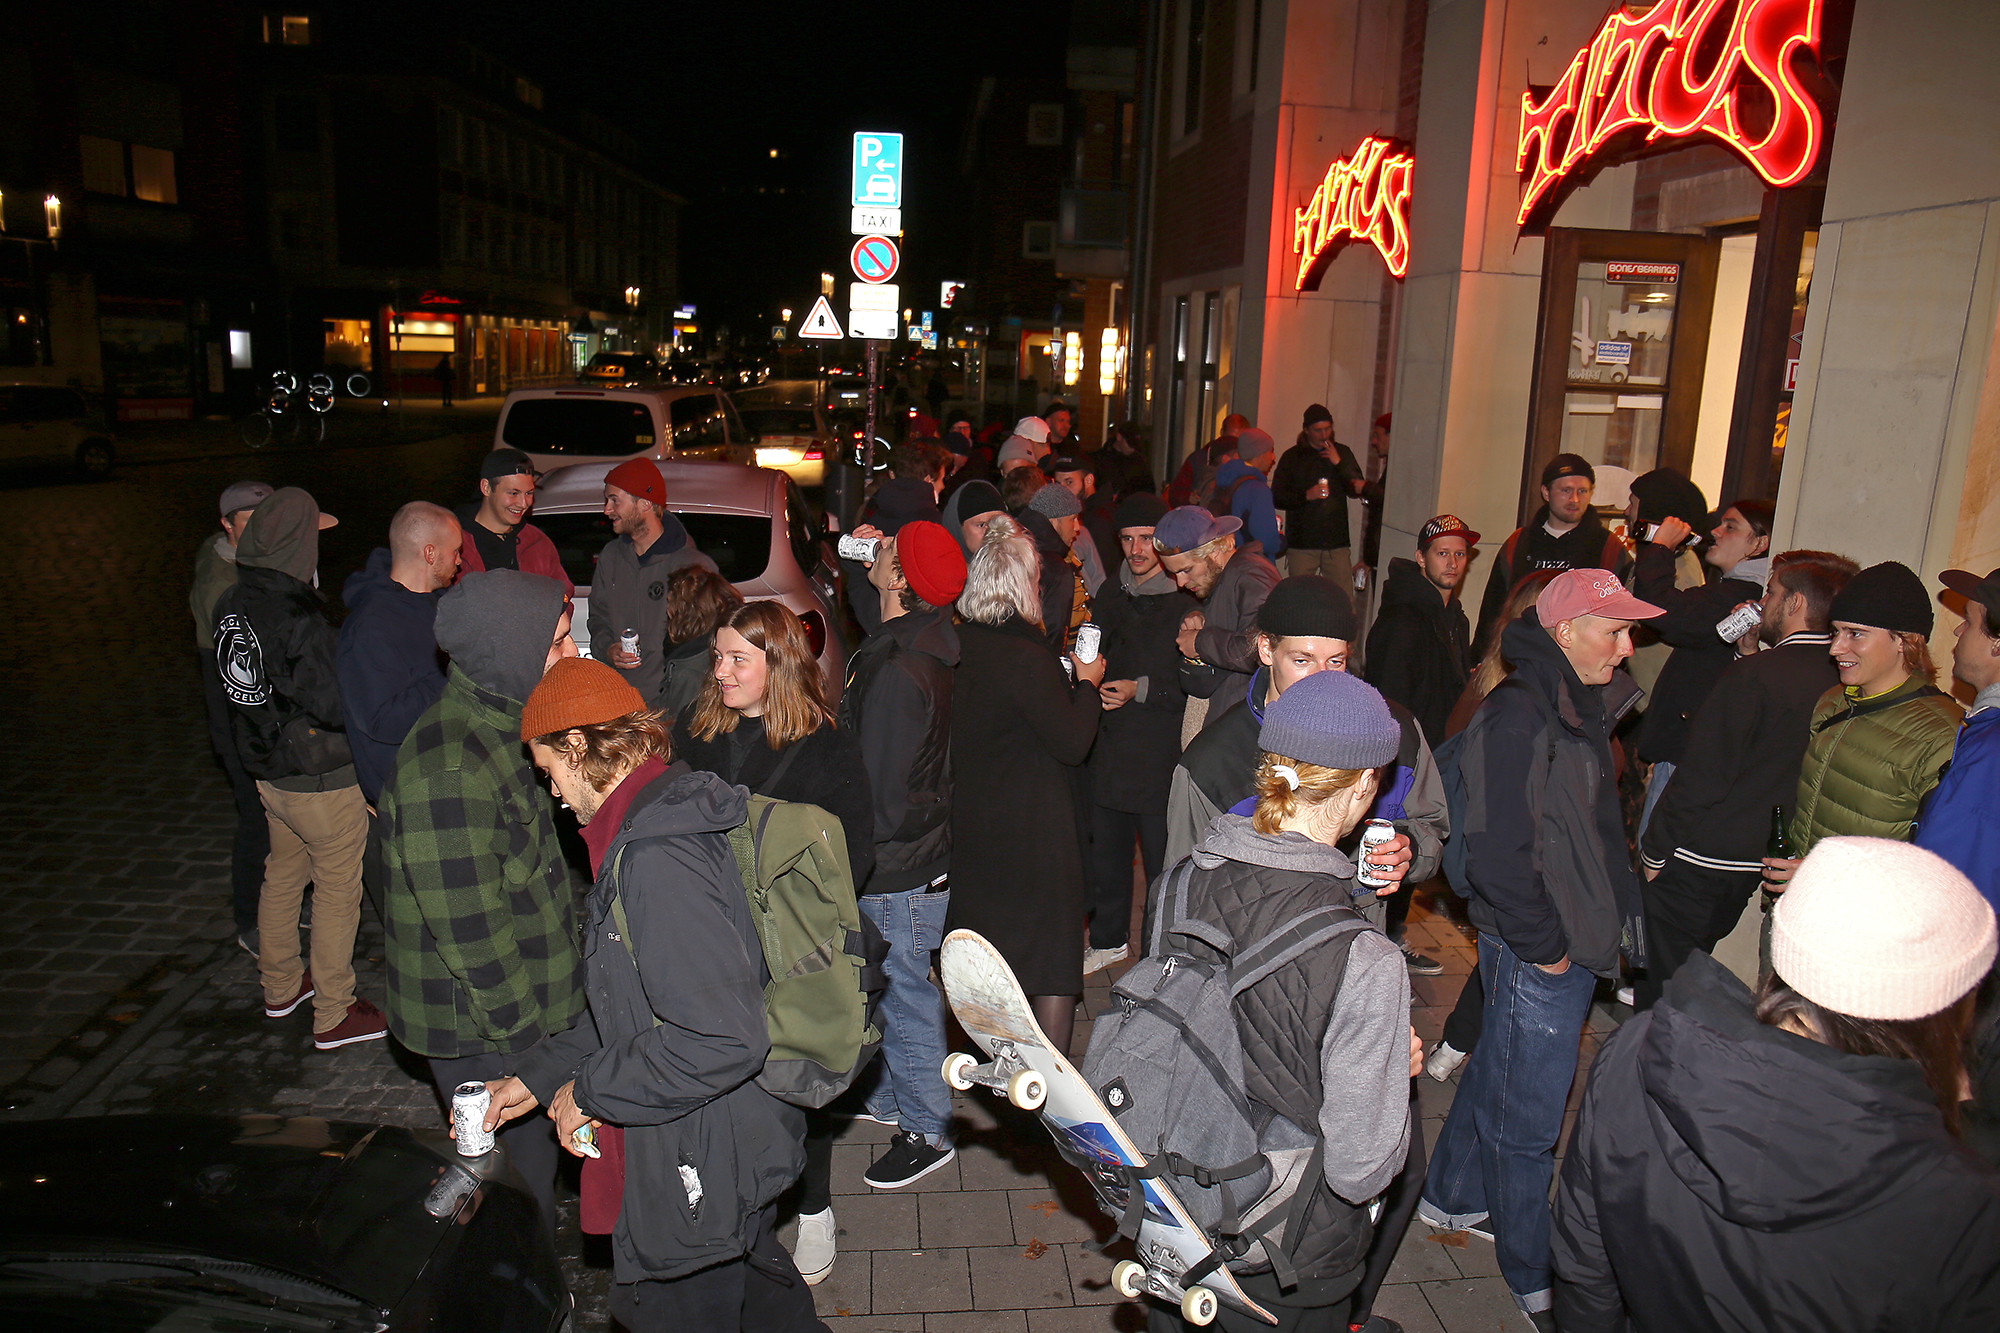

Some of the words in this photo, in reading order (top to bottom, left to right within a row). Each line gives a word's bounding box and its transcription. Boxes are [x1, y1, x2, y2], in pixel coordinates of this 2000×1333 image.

[861, 137, 883, 168] P
[861, 214, 893, 228] TAXI
[1599, 344, 1621, 352] adidas
